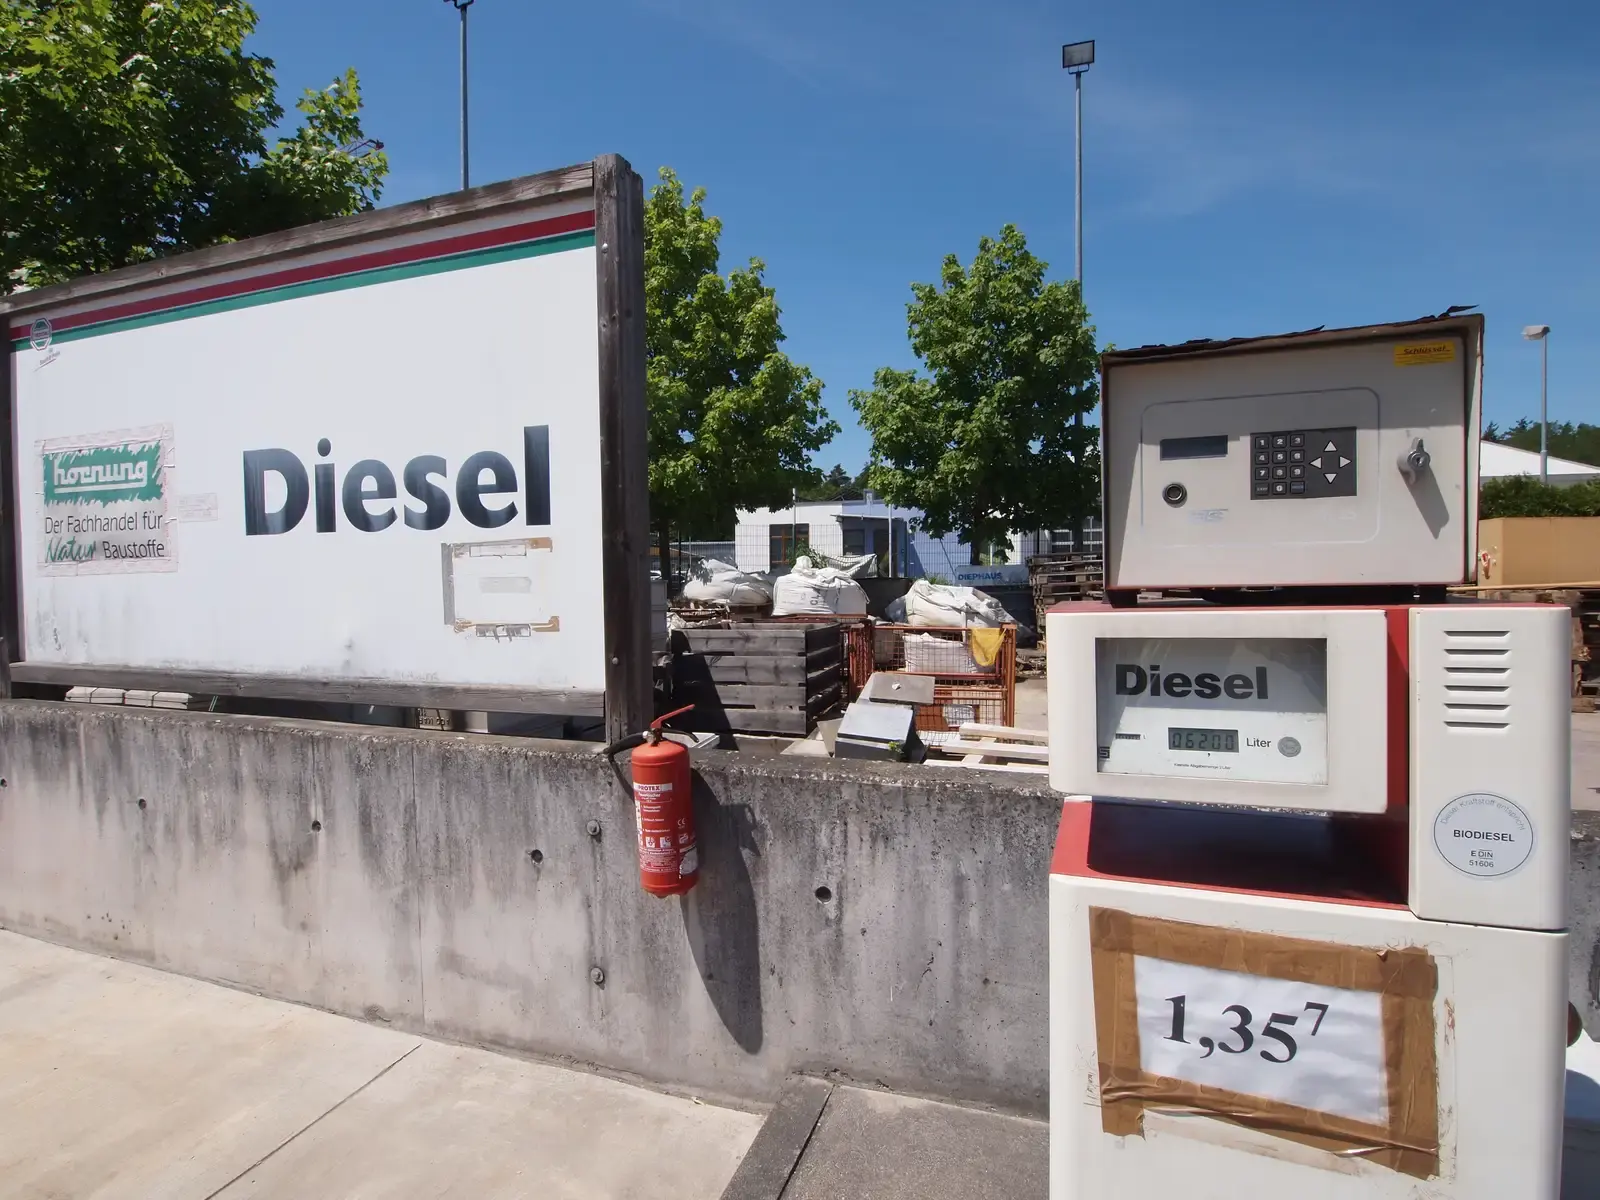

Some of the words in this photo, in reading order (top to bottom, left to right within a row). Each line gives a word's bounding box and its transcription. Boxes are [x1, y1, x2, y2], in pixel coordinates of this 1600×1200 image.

[54, 459, 148, 488] hornung
[243, 425, 551, 536] Diesel
[45, 516, 64, 534] Der
[67, 512, 138, 533] Fachhandel
[142, 511, 163, 531] für
[45, 536, 97, 563] Natur
[102, 540, 165, 559] Baustoffe
[957, 572, 1003, 581] DIEPHAUS
[1115, 664, 1268, 700] Diesel
[1246, 737, 1272, 748] Liter
[1459, 797, 1496, 808] Kraftstoff
[1496, 803, 1526, 831] entspricht
[1453, 829, 1515, 842] BIODIESEL
[1468, 859, 1494, 868] 51606
[1478, 849, 1494, 859] DIN
